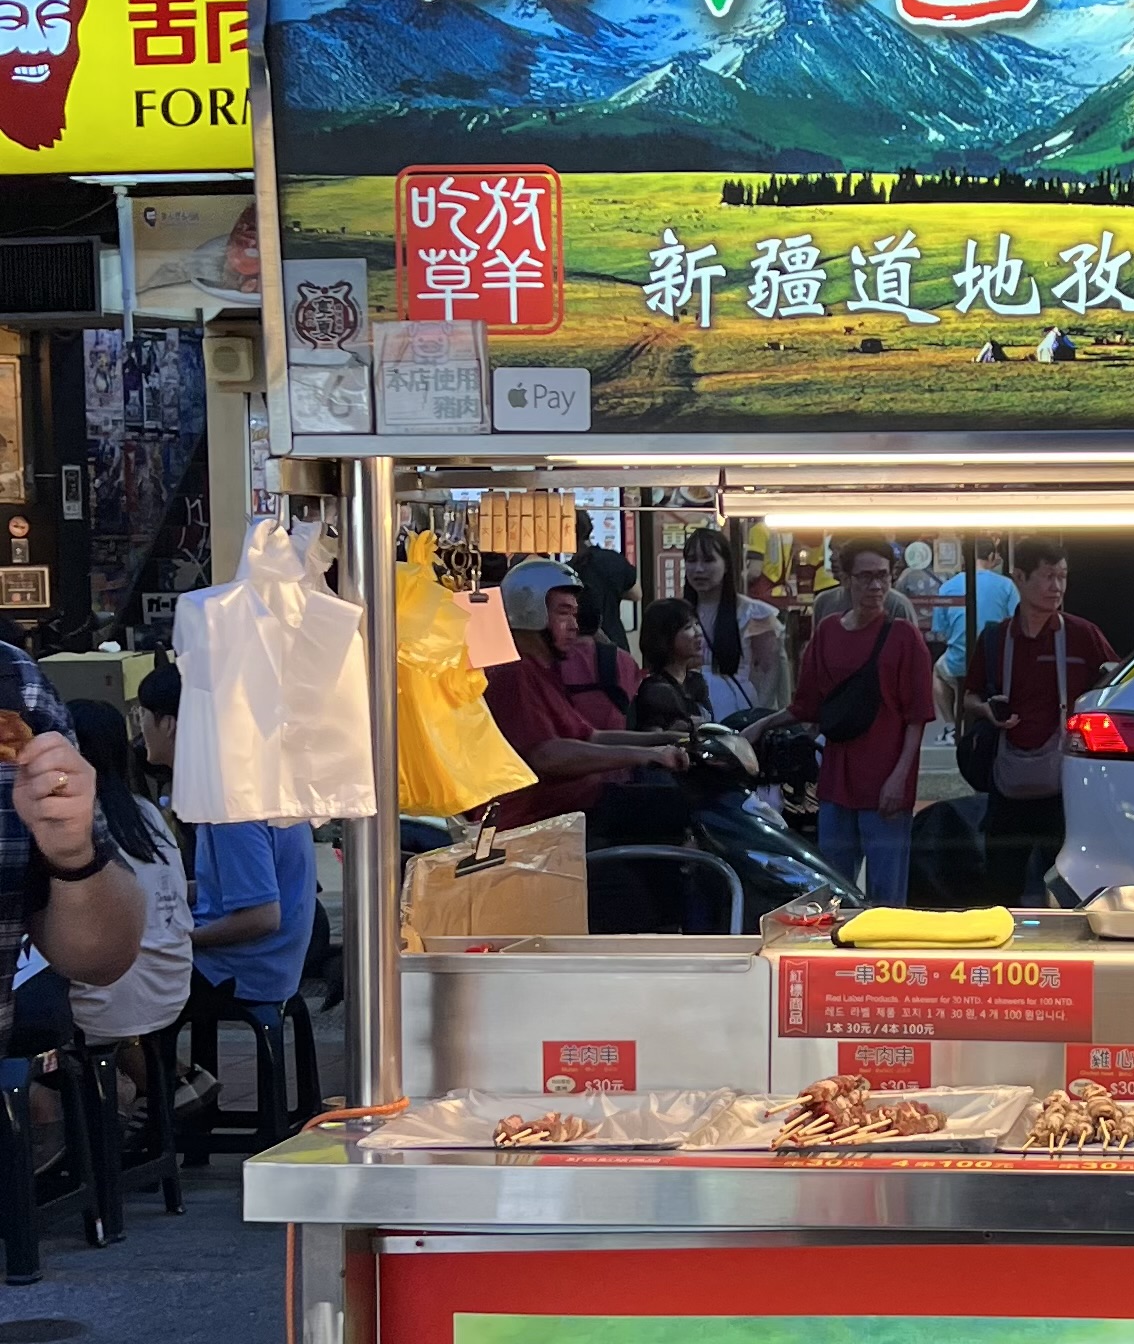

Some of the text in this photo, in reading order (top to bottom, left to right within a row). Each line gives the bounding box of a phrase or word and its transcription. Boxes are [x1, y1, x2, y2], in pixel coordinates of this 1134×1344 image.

[134, 87, 252, 128] FOR
[386, 368, 480, 394] 本店使用
[533, 383, 576, 416] Pay
[560, 1045, 619, 1066] 羊肉串
[855, 1045, 914, 1066] 牛肉串
